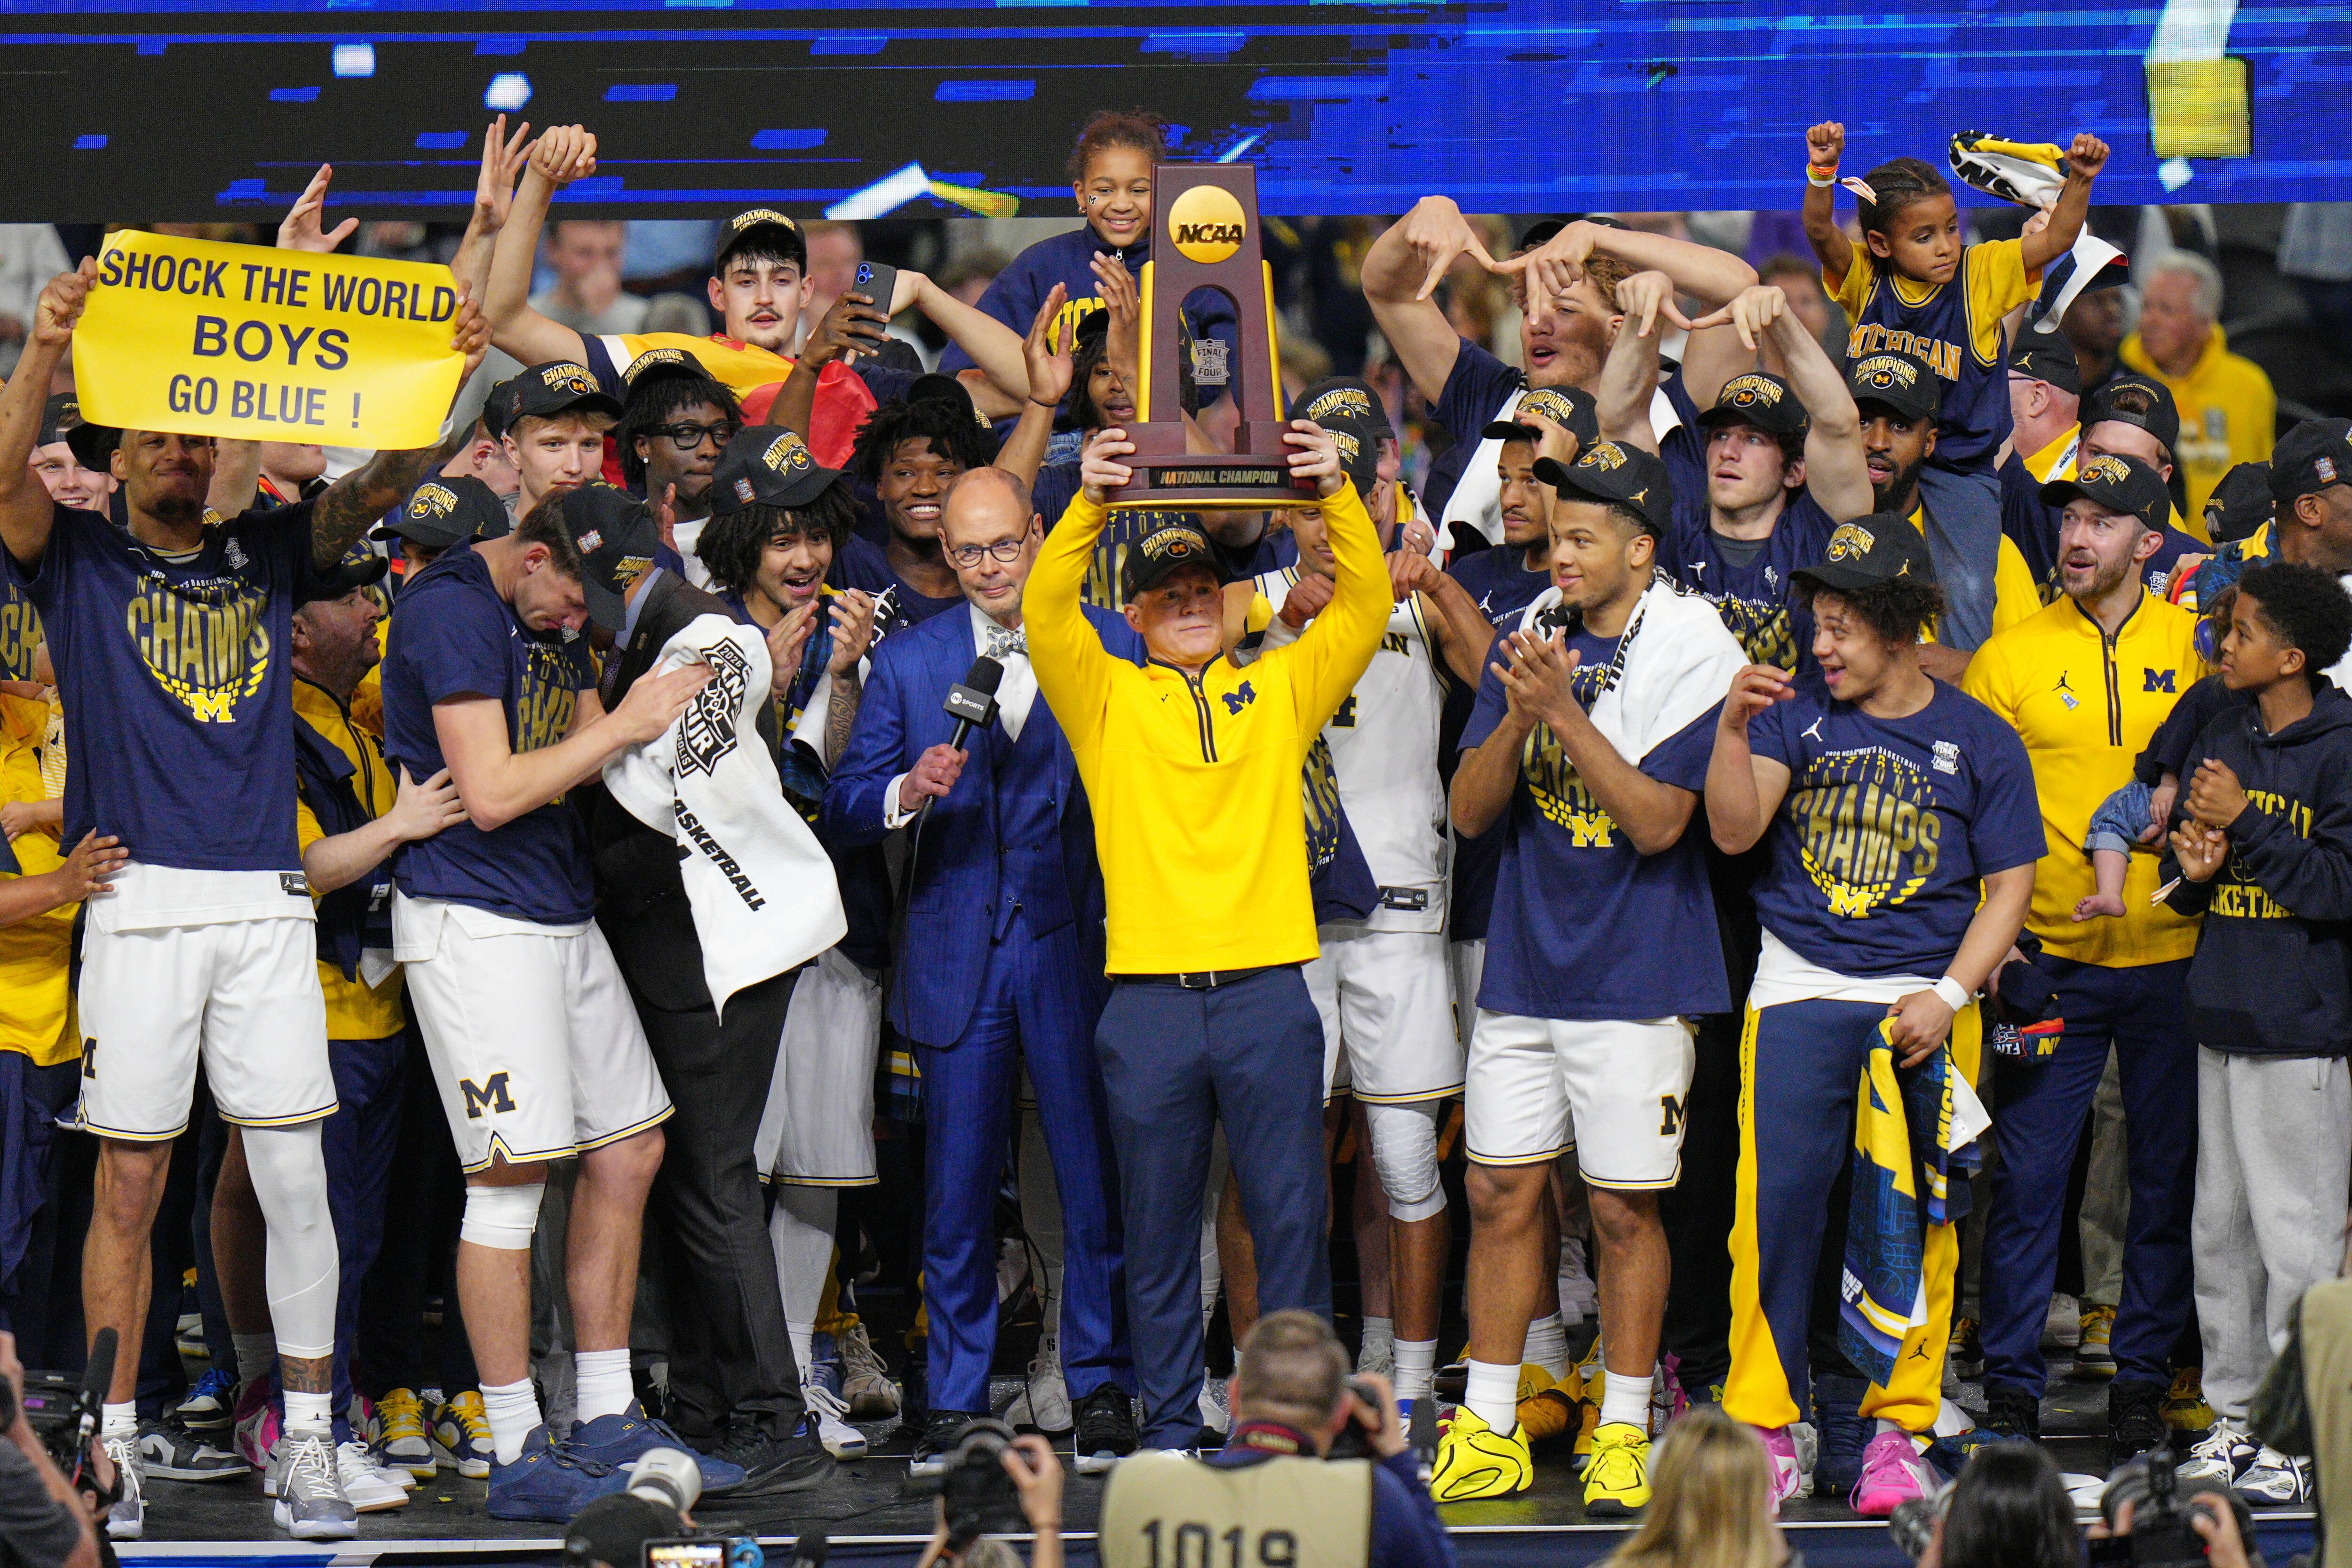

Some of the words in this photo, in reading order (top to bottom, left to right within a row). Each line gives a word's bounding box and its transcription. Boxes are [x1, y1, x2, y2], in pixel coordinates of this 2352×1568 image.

[733, 211, 795, 231] CHAMPIONS
[1176, 222, 1243, 244] NCAA
[99, 248, 229, 299] SHOCK
[240, 263, 311, 307] THE
[324, 273, 456, 322] WORLD
[193, 314, 350, 370] BOYS
[1197, 348, 1223, 357] FINAL
[1846, 323, 1962, 381] MICHIGAN
[543, 366, 600, 392] CHAMPIO
[626, 350, 684, 386] CHAMPIONS
[1199, 367, 1223, 376] FOUR
[1855, 358, 1917, 384] CHAMPIONS
[1875, 374, 1890, 384] M
[572, 381, 587, 392] M
[1737, 392, 1754, 403] M
[168, 374, 219, 416] GO
[231, 381, 327, 426] BLUE
[351, 392, 361, 429] !
[1309, 391, 1370, 421] CHAMPIONS
[1519, 392, 1572, 419] AMPIONS
[765, 435, 807, 470] CHAMPI
[1329, 433, 1359, 456] PIONS
[2059, 455, 2071, 469] FINAL
[2069, 445, 2078, 456] FOUR
[792, 452, 807, 465] M
[2082, 456, 2130, 482] MPIONS
[2316, 461, 2332, 470] FINAL
[735, 482, 749, 491] FINAL
[1160, 470, 1216, 485] NATIONAL
[1219, 470, 1279, 485] CHAMPION
[412, 486, 457, 512] MPIONS
[413, 503, 429, 514] M
[739, 491, 753, 500] FOUR
[1830, 526, 1874, 554] MPIONS
[127, 591, 270, 687] CHAMPS
[719, 647, 742, 668] 2026
[2143, 668, 2177, 692] M
[189, 691, 233, 723] M
[962, 698, 985, 711] SPORTS
[1222, 680, 1257, 716] M
[1878, 745, 1921, 772] BASKETBALL
[1571, 815, 1611, 847] M
[1791, 782, 1941, 883] CHAMPS
[674, 795, 767, 912] ASKETBALL
[1828, 884, 1872, 919] M
[459, 1071, 518, 1119] M
[1142, 1518, 1298, 1568] 1019
